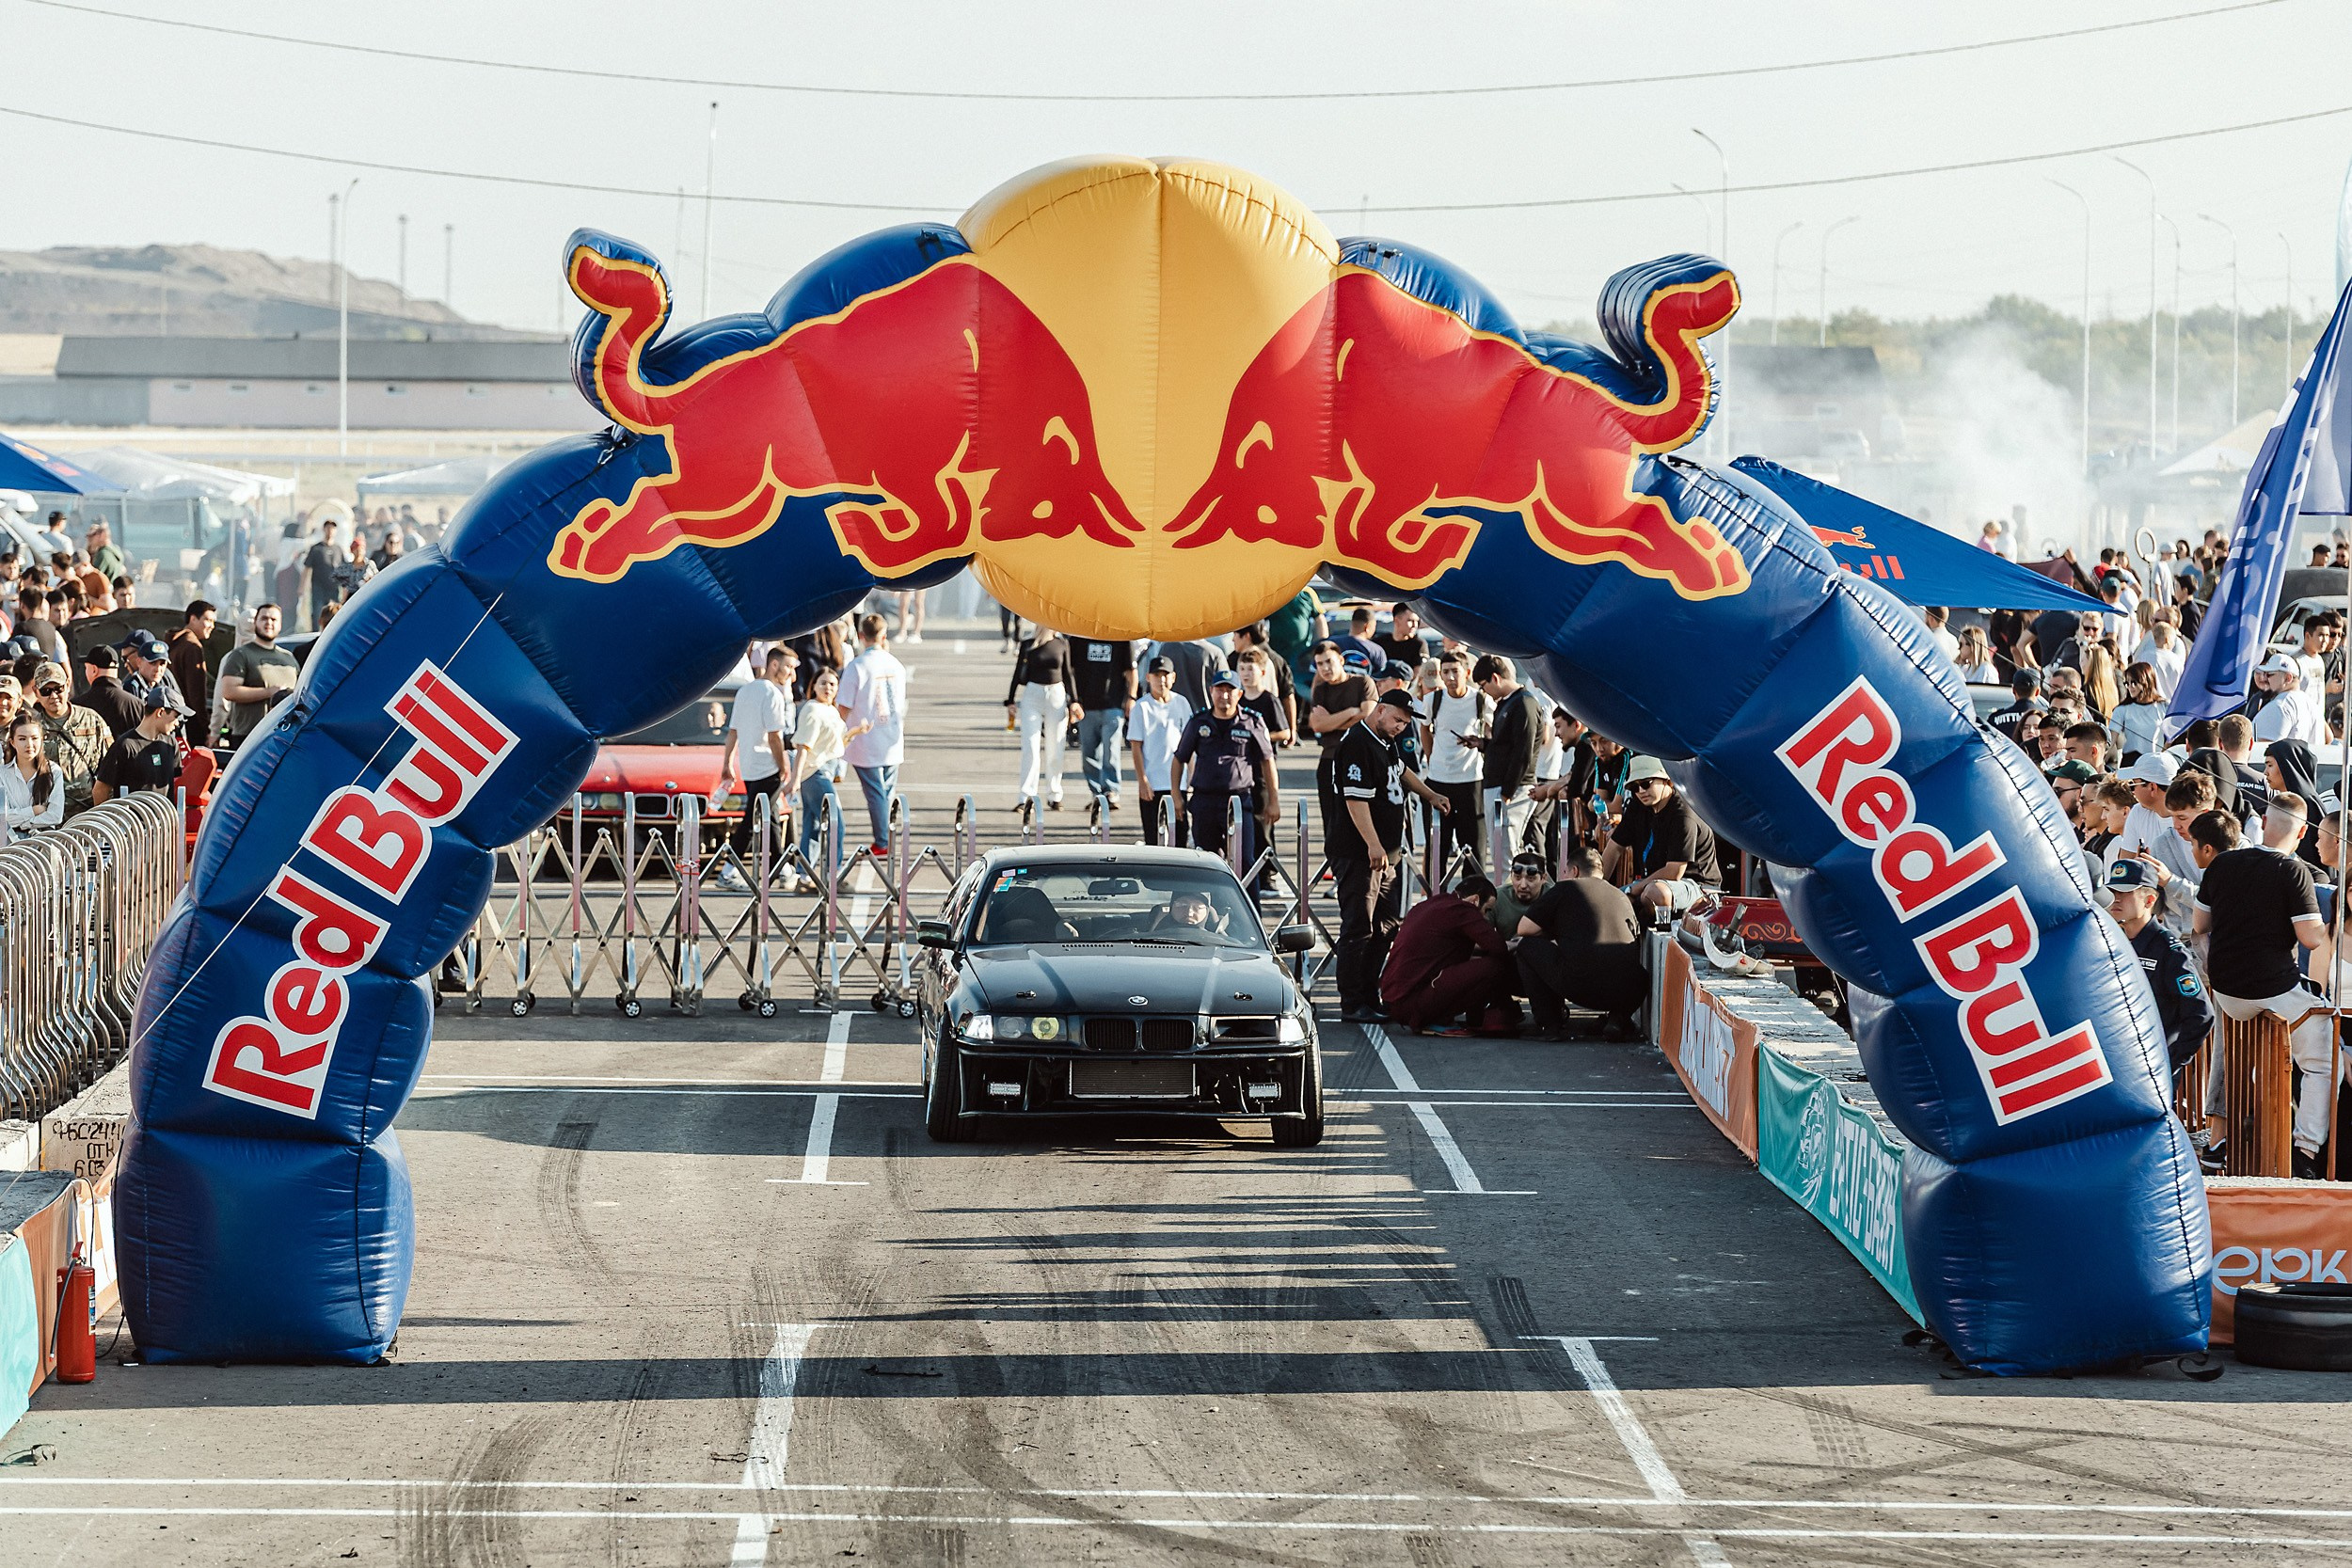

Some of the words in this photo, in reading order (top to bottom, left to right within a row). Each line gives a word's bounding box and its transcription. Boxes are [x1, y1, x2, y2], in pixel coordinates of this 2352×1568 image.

[211, 873, 379, 1112] Red
[309, 668, 510, 896] Bull
[1785, 684, 1999, 914] Red
[1922, 895, 2106, 1117] Bull
